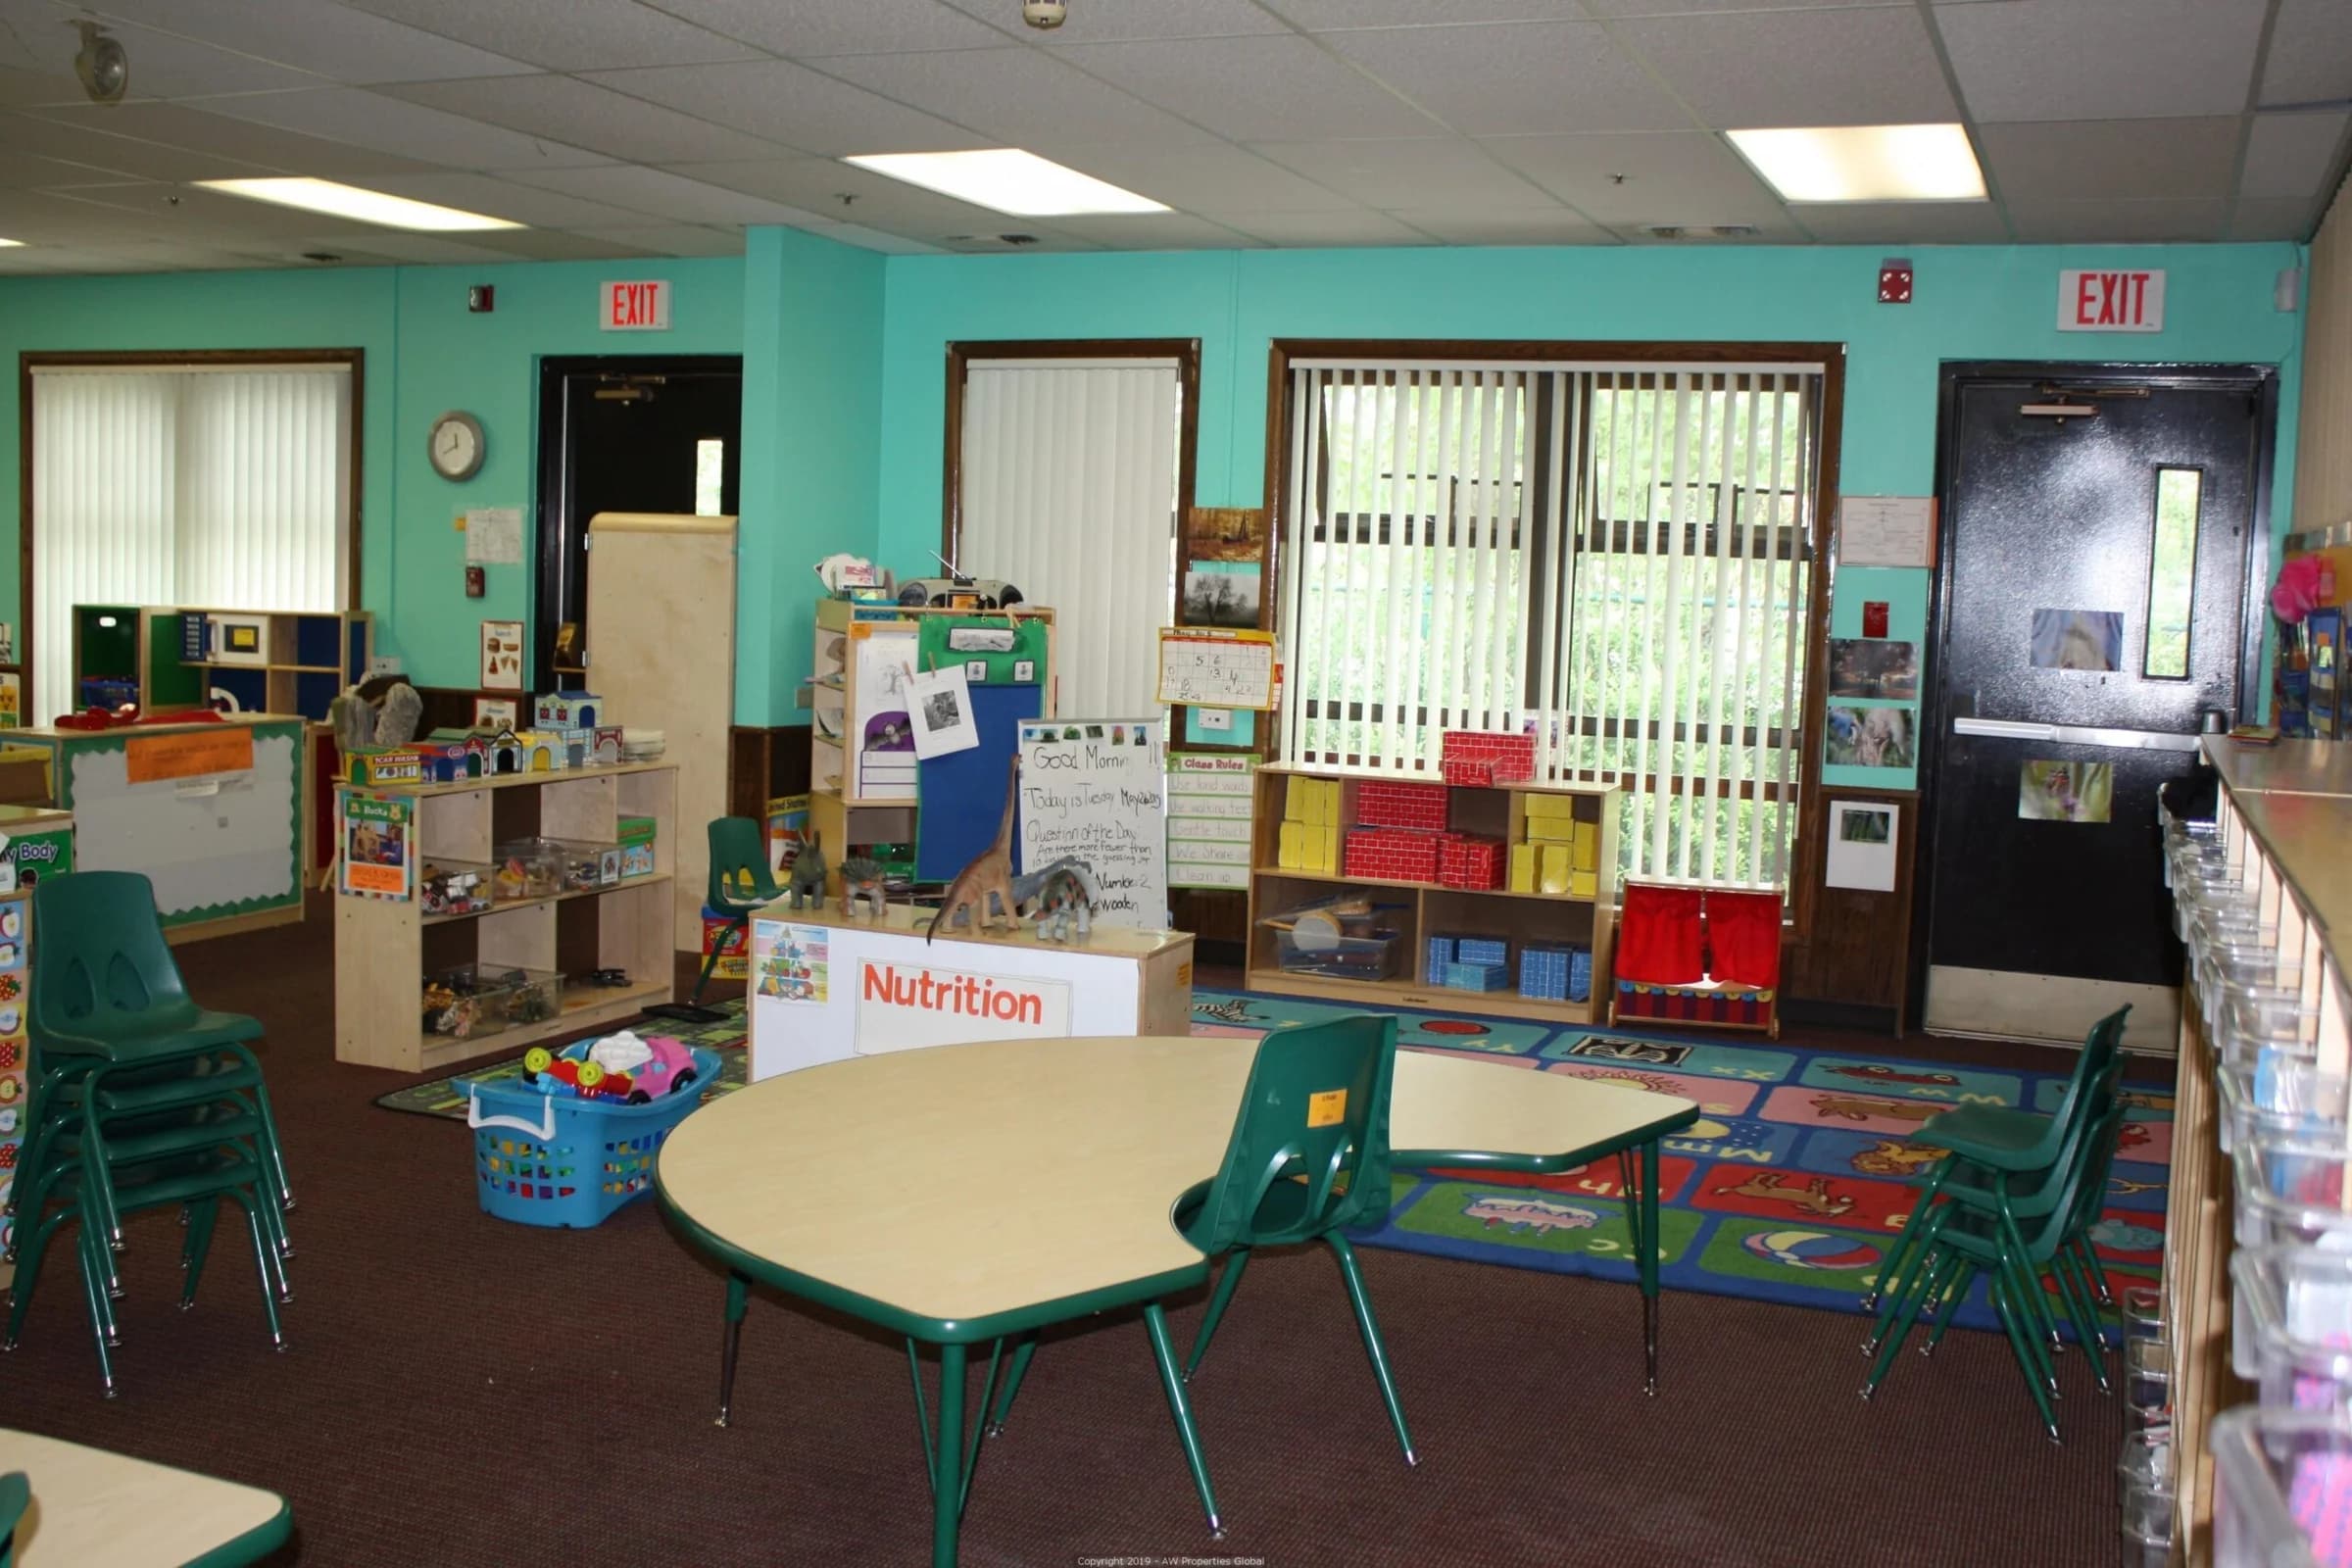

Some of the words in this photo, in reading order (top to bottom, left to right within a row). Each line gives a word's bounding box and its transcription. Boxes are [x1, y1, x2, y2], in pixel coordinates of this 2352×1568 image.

[612, 282, 658, 325] EXIT
[2077, 273, 2150, 325] EXIT
[1033, 745, 1079, 769] Good
[1184, 759, 1214, 770] Class
[1215, 759, 1244, 771] Rules
[1023, 787, 1067, 819] Today
[1070, 792, 1083, 808] is
[1074, 782, 1115, 811] Tuesday
[1092, 821, 1114, 843] the
[1115, 819, 1137, 841] Day
[20, 840, 59, 863] Body
[1079, 843, 1100, 853] more
[1129, 841, 1152, 856] than
[864, 963, 1042, 1025] Nutrition
